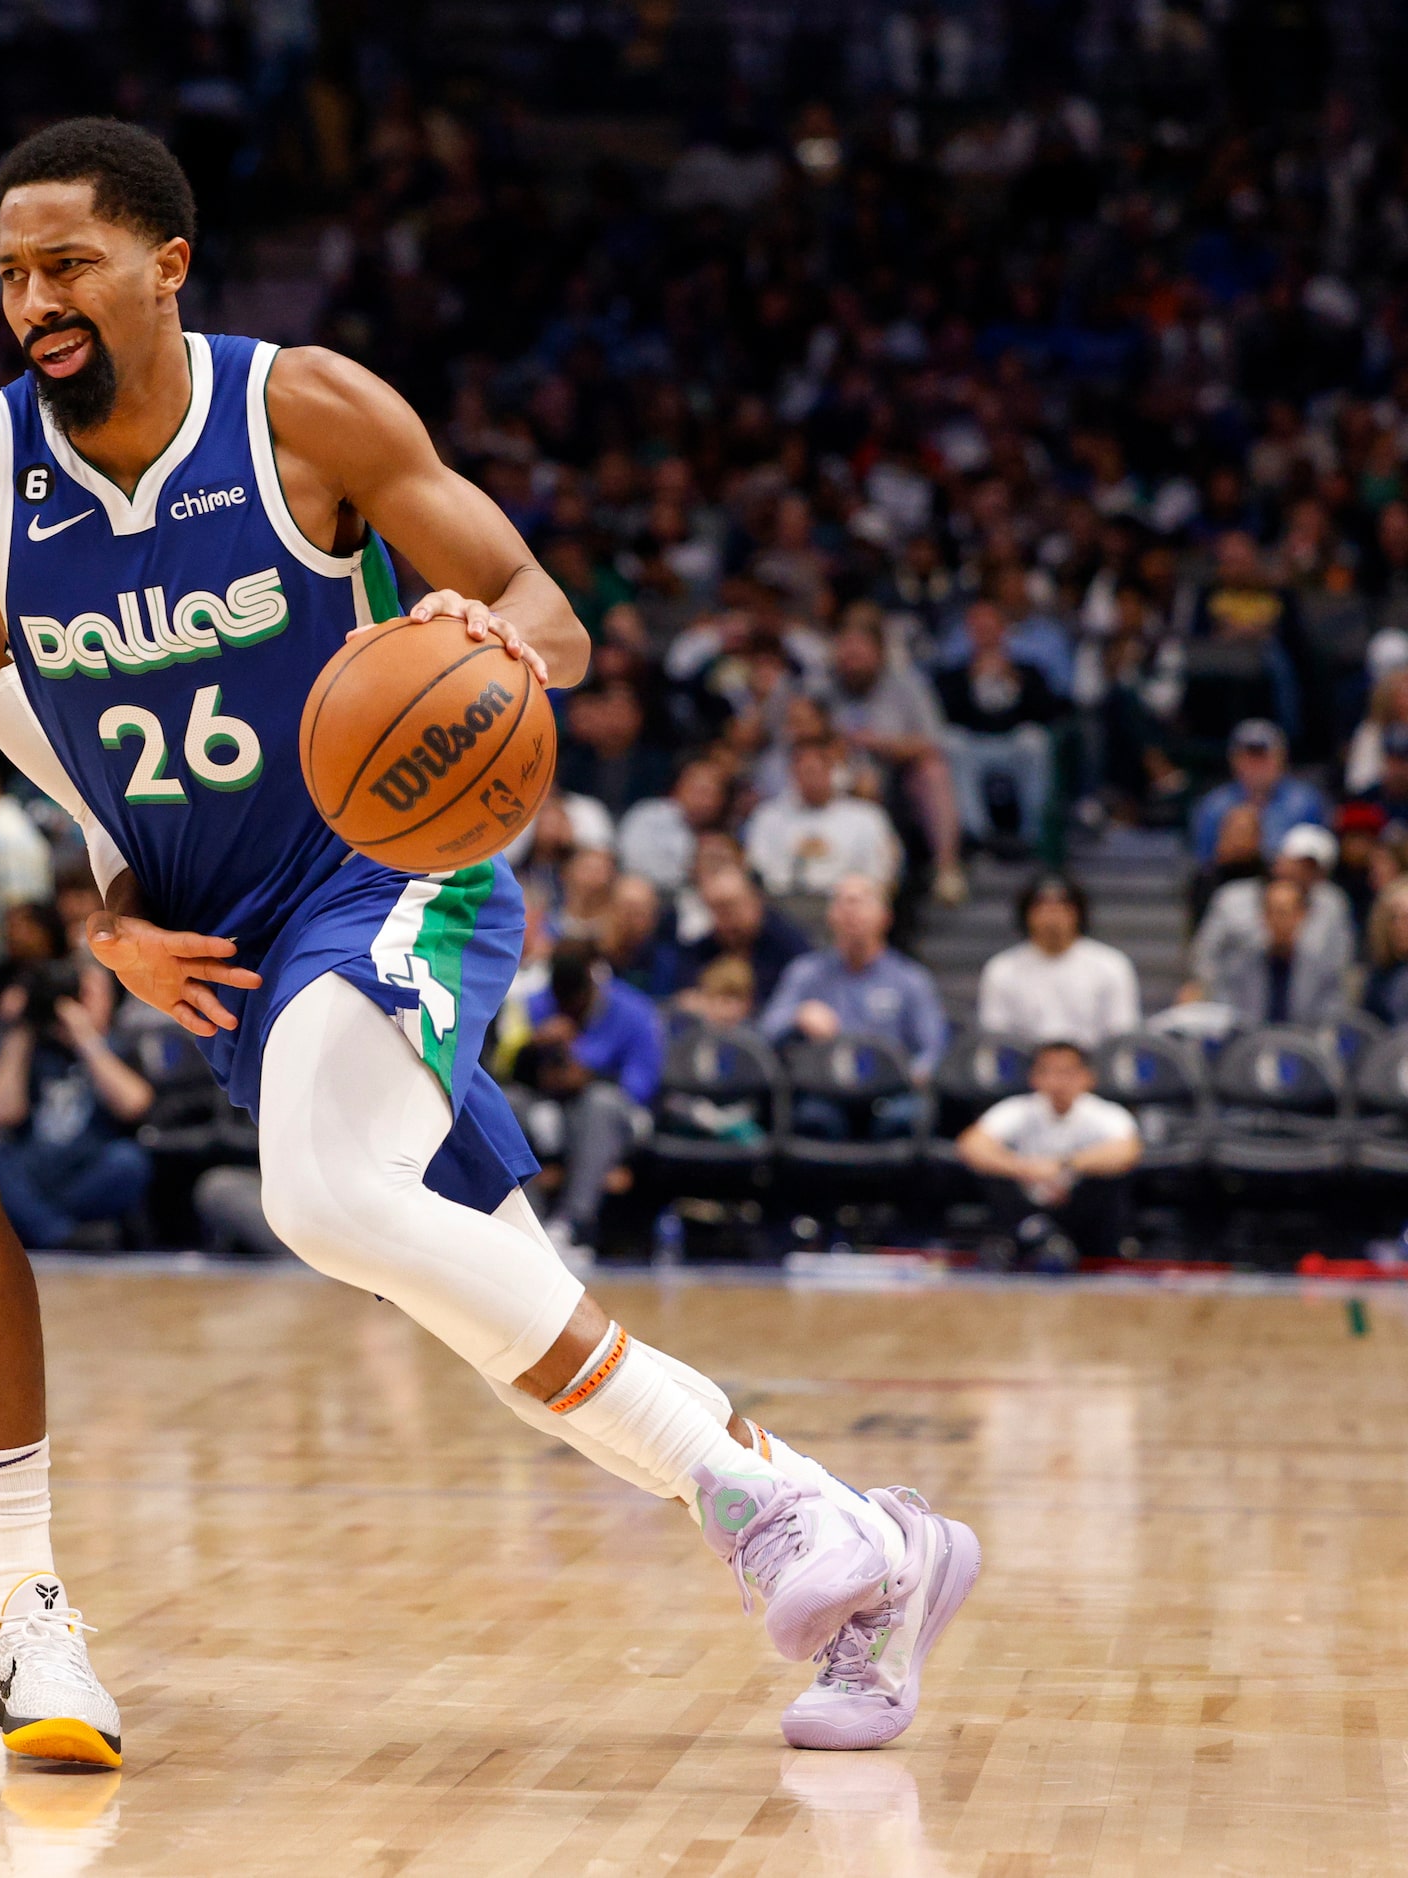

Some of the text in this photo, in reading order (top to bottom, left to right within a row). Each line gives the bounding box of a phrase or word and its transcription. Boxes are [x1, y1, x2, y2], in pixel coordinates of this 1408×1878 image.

[25, 469, 48, 500] 6
[170, 486, 247, 520] chime
[98, 684, 264, 805] 26
[369, 681, 514, 812] Wilson
